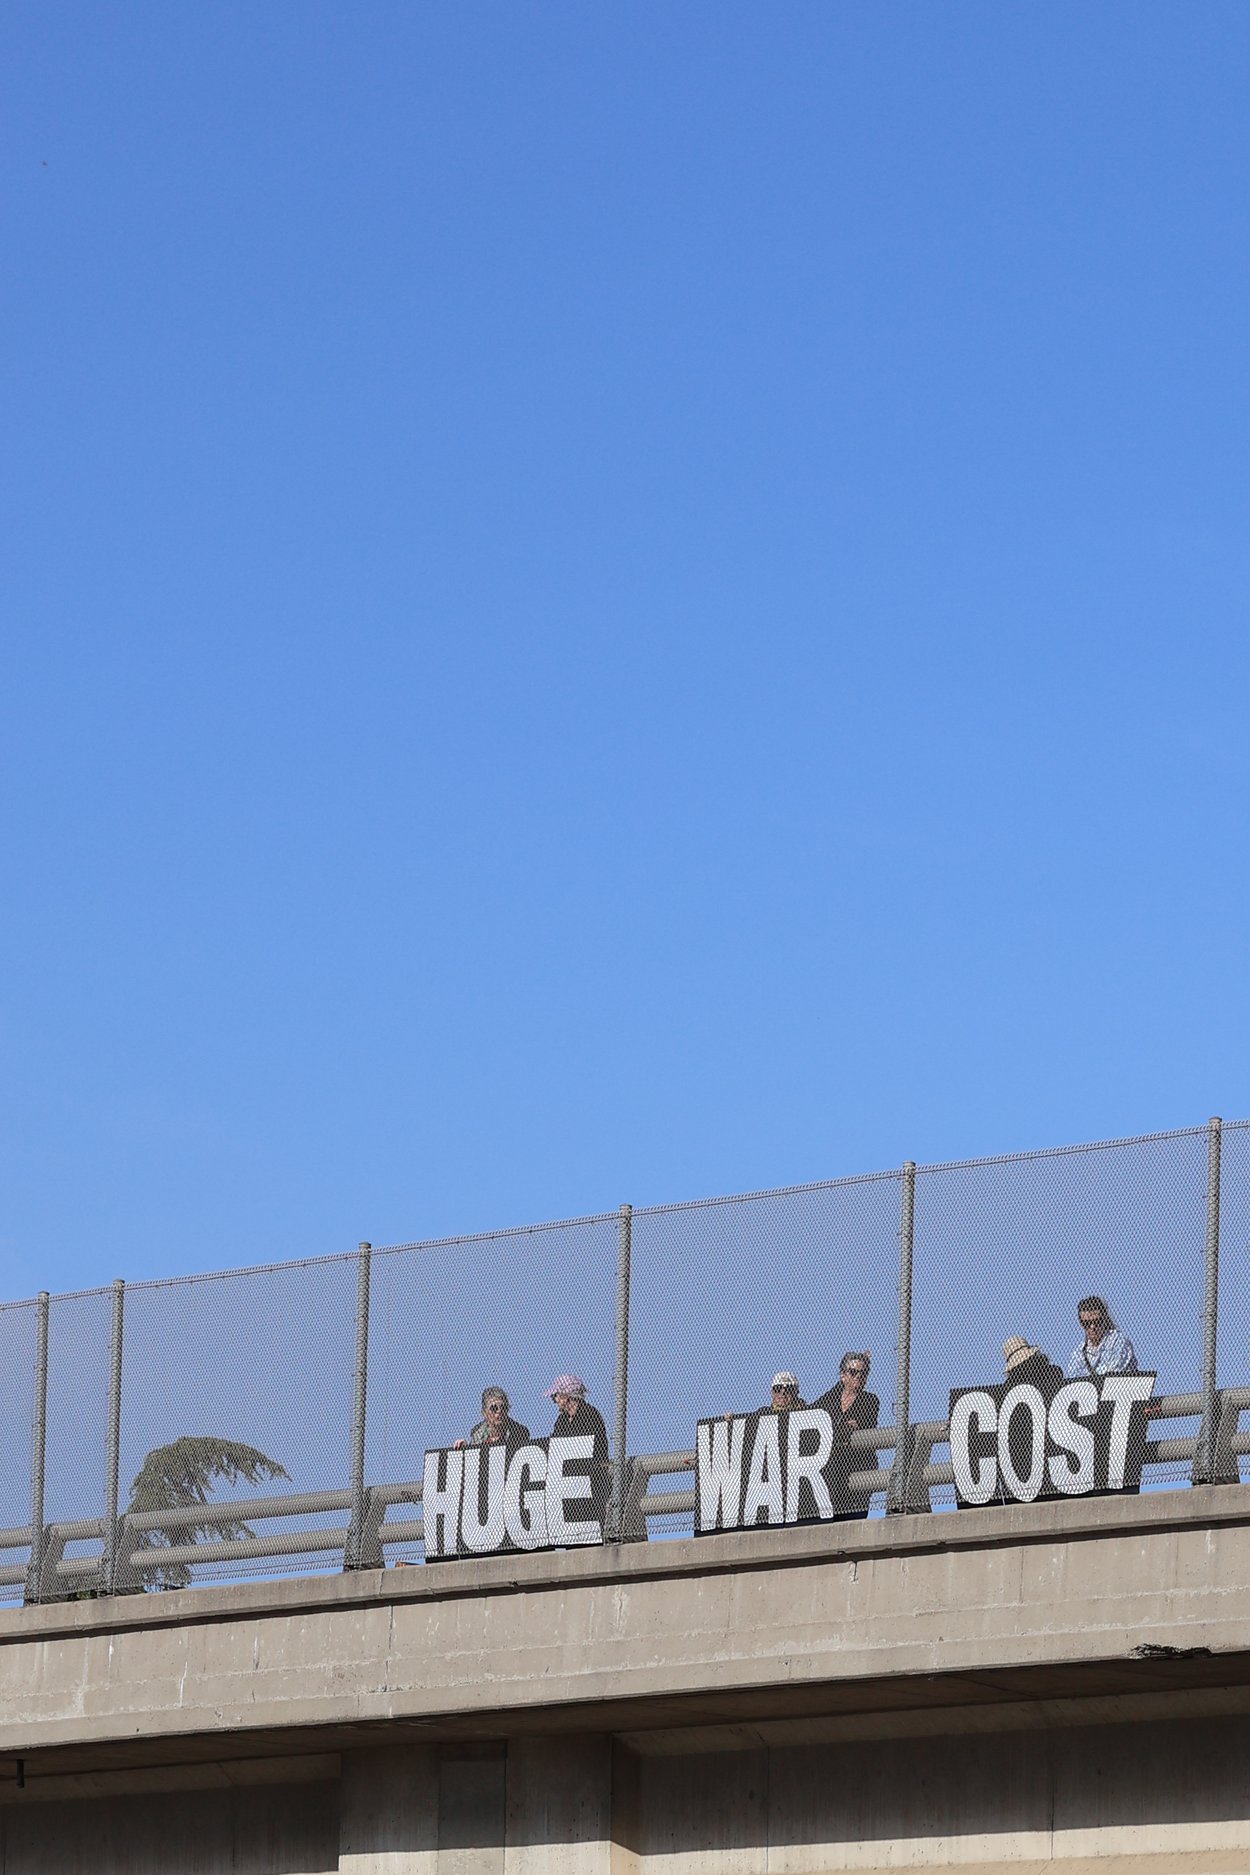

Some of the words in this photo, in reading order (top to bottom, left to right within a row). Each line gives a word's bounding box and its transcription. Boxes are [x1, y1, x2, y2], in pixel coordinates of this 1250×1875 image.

[424, 1435, 603, 1556] HUGE
[696, 1408, 835, 1531] WAR
[949, 1376, 1155, 1505] COST
